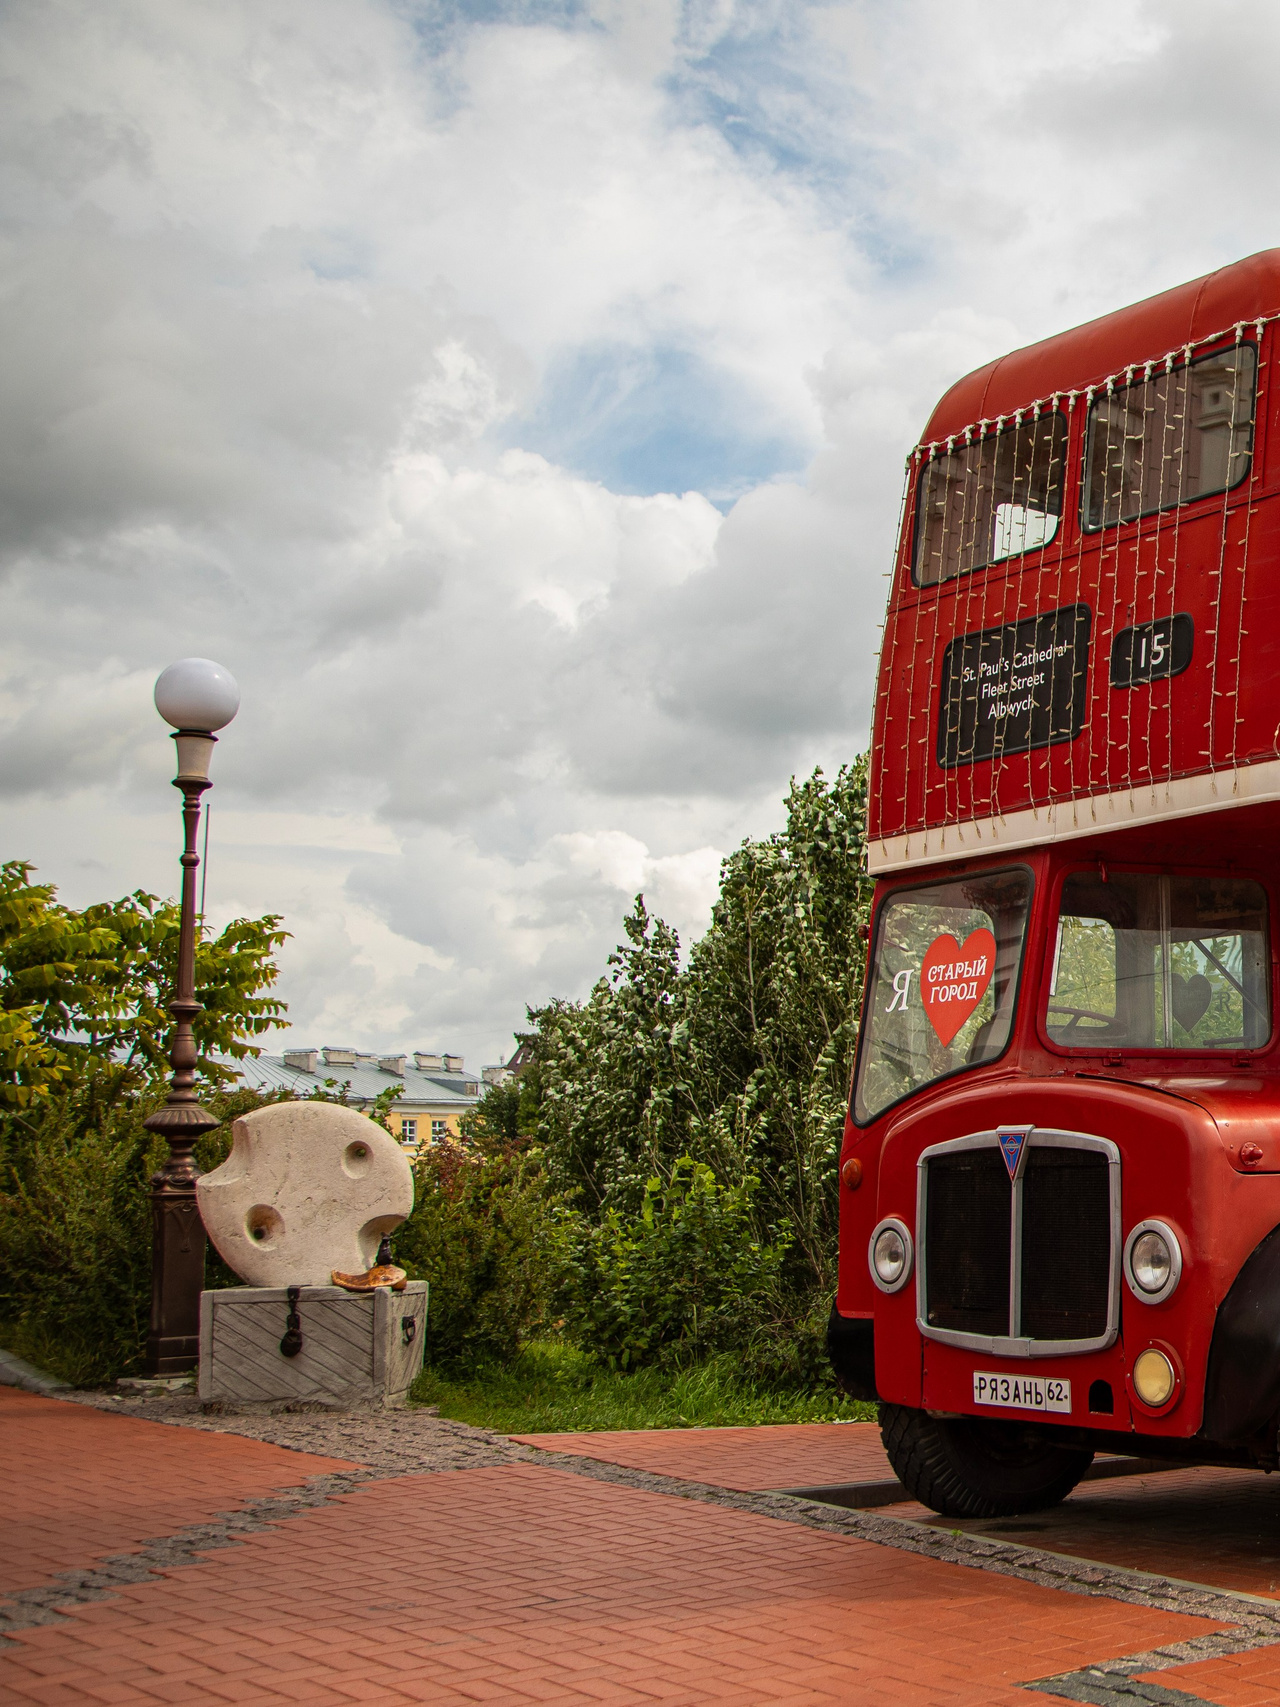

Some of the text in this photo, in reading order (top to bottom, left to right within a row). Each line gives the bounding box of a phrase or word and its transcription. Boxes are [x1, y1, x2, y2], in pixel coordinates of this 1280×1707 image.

[963, 667, 977, 682] St.
[1014, 640, 1068, 668] Cathedral
[1141, 633, 1164, 668] 15
[981, 672, 1045, 699] Fleet Street
[927, 955, 988, 983] СТАРЫЙ
[885, 968, 915, 1013] Я
[929, 981, 978, 1004] ГОРОД
[978, 1376, 1064, 1406] РЯЗАНЬ 62
